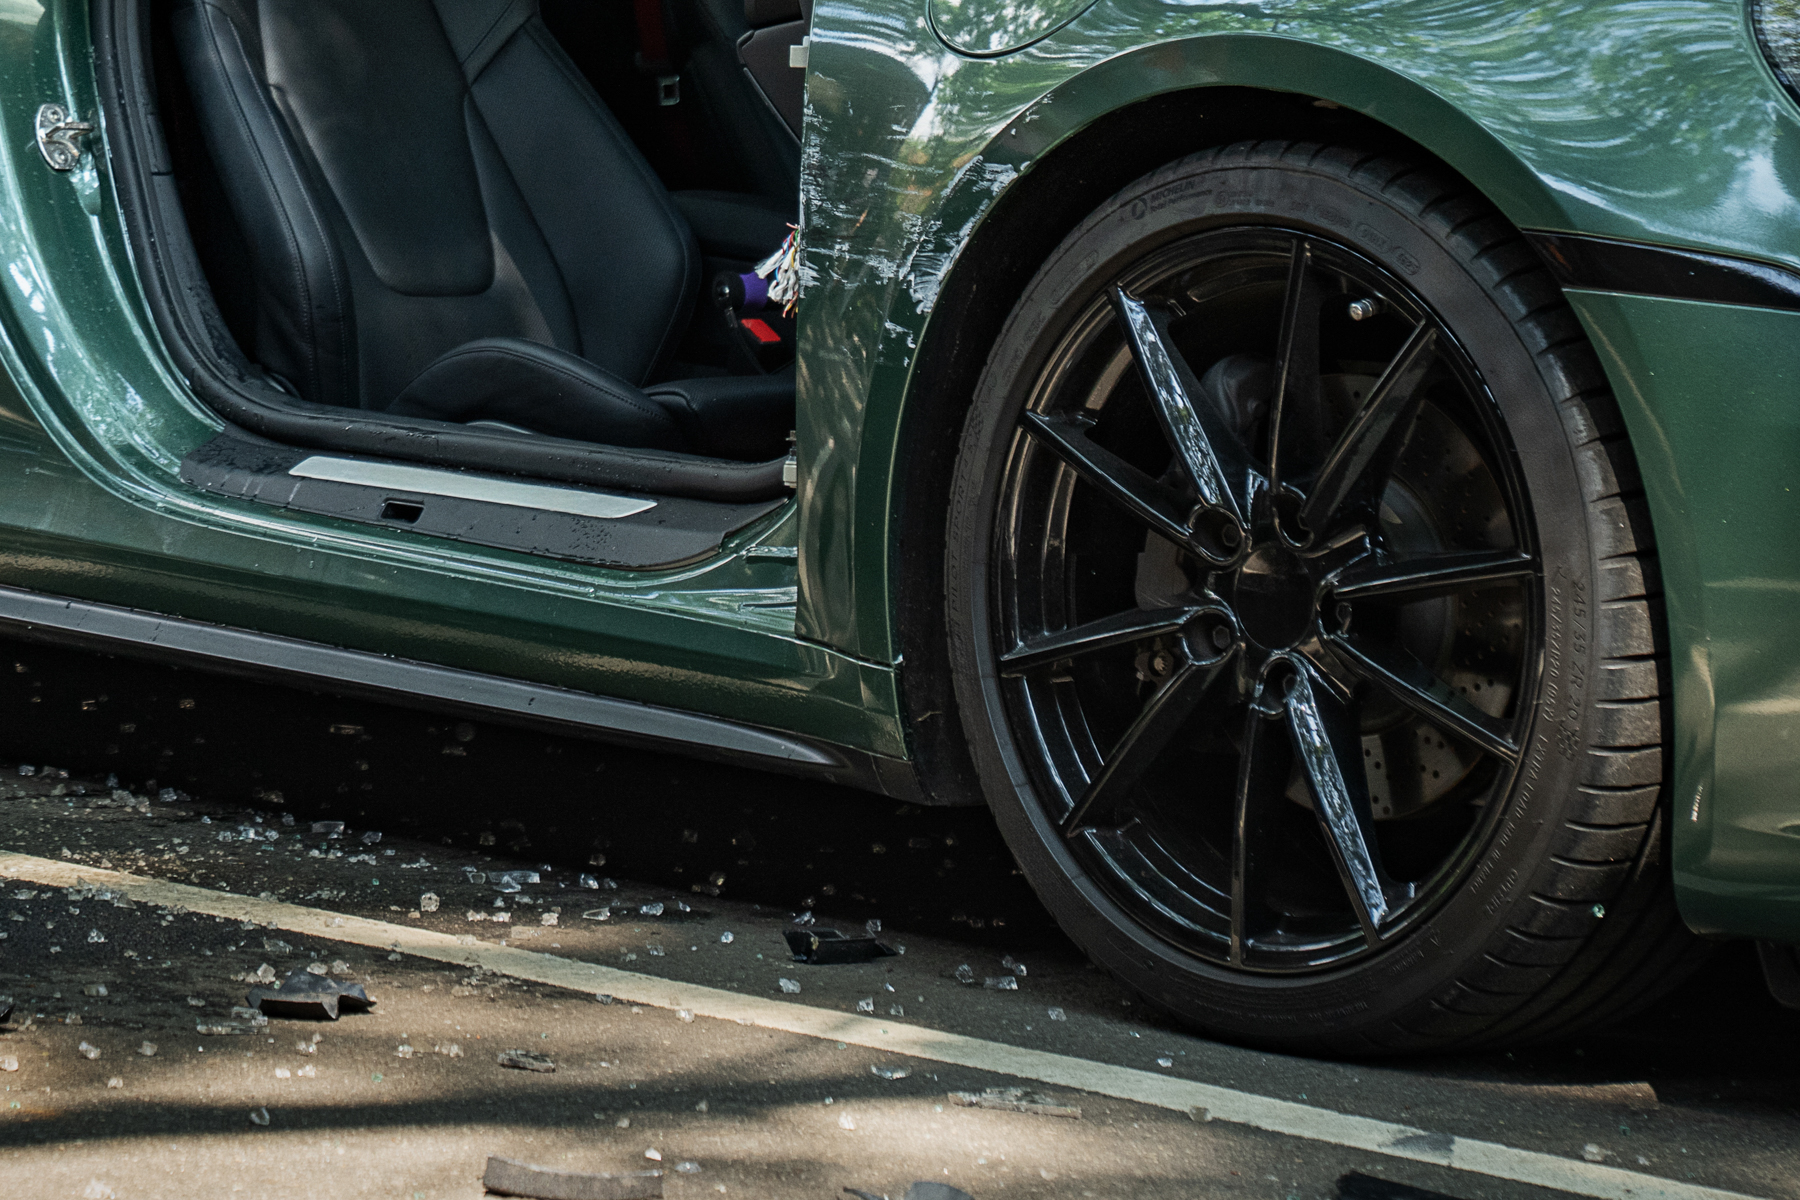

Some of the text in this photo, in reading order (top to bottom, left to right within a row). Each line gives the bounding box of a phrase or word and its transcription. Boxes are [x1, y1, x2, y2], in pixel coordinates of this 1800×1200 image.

[1150, 180, 1196, 203] MICHELIN
[1567, 580, 1587, 722] 245/35 ZR 20
